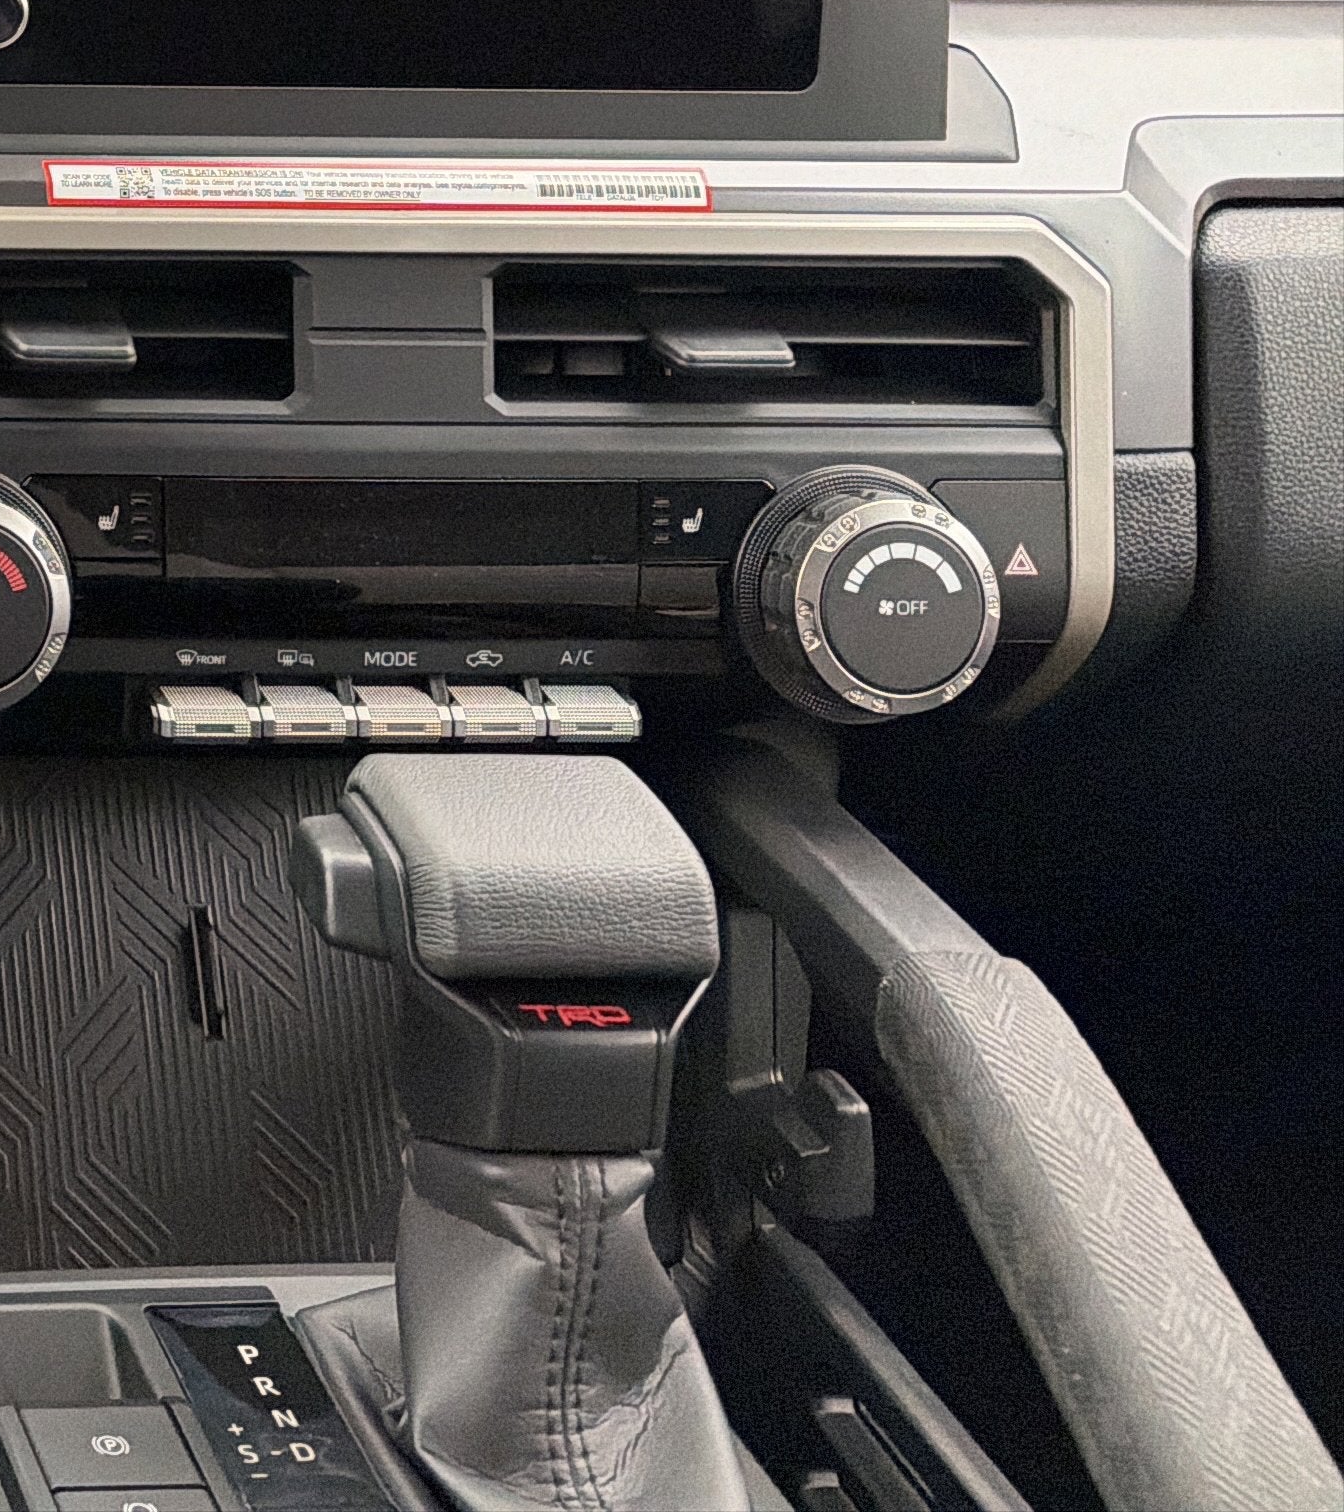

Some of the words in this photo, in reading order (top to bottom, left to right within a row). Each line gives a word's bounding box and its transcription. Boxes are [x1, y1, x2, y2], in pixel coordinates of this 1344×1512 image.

[255, 188, 272, 197] SOS
[315, 189, 325, 197] BE
[326, 190, 362, 198] REMOVED
[362, 190, 373, 198] BY
[374, 190, 402, 199] OWNER
[402, 191, 422, 199] ONLY
[896, 600, 929, 616] OFF
[196, 655, 227, 665] FRONT
[364, 651, 418, 667] MODE
[560, 649, 595, 666] A/C
[518, 1003, 632, 1028] TRD
[237, 1344, 260, 1365] P
[252, 1375, 282, 1398] R
[271, 1408, 300, 1428] N
[237, 1444, 260, 1464] S
[289, 1442, 316, 1463] D
